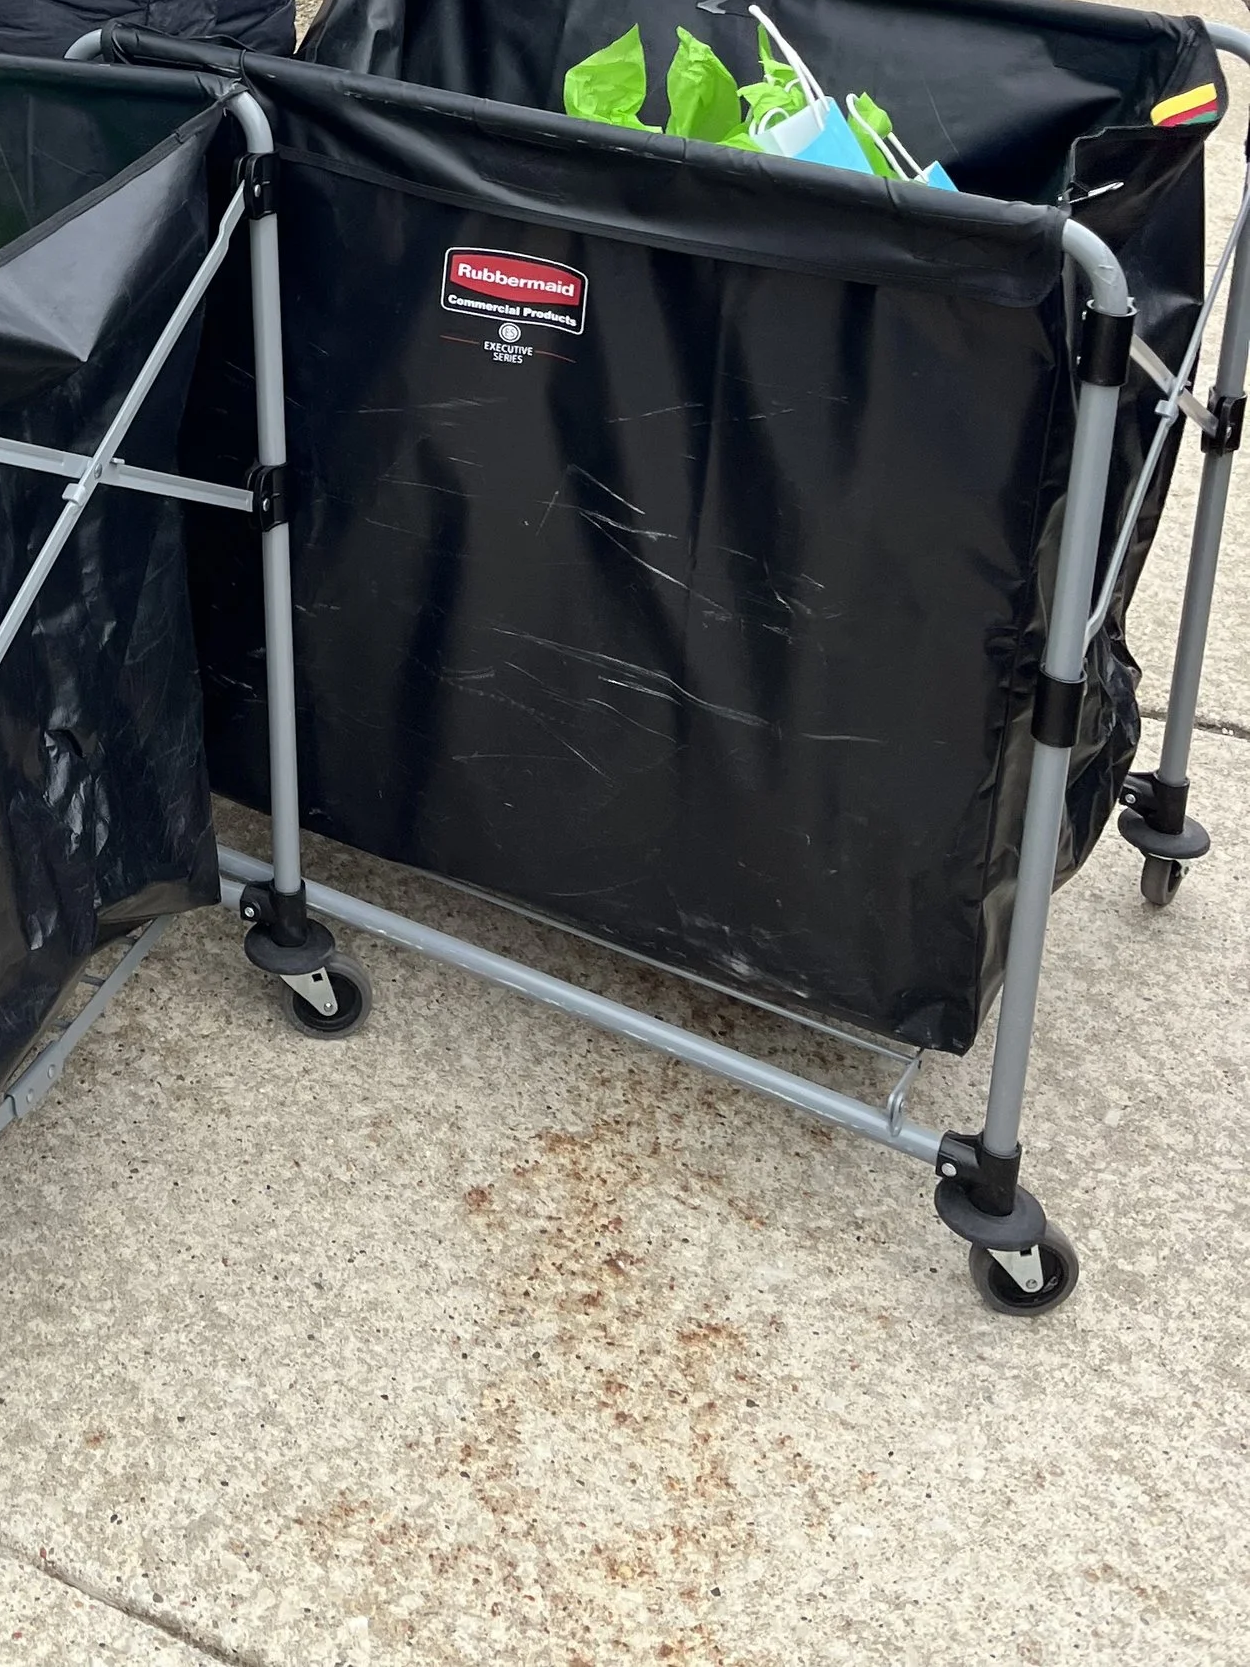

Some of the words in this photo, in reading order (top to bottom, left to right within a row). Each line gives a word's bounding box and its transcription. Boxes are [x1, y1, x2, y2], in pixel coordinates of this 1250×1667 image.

[458, 263, 575, 297] Rubbermaid
[448, 294, 520, 316] Commercial
[523, 307, 577, 327] Products
[484, 341, 534, 356] EXECUTIVE
[493, 352, 523, 364] SERIES
